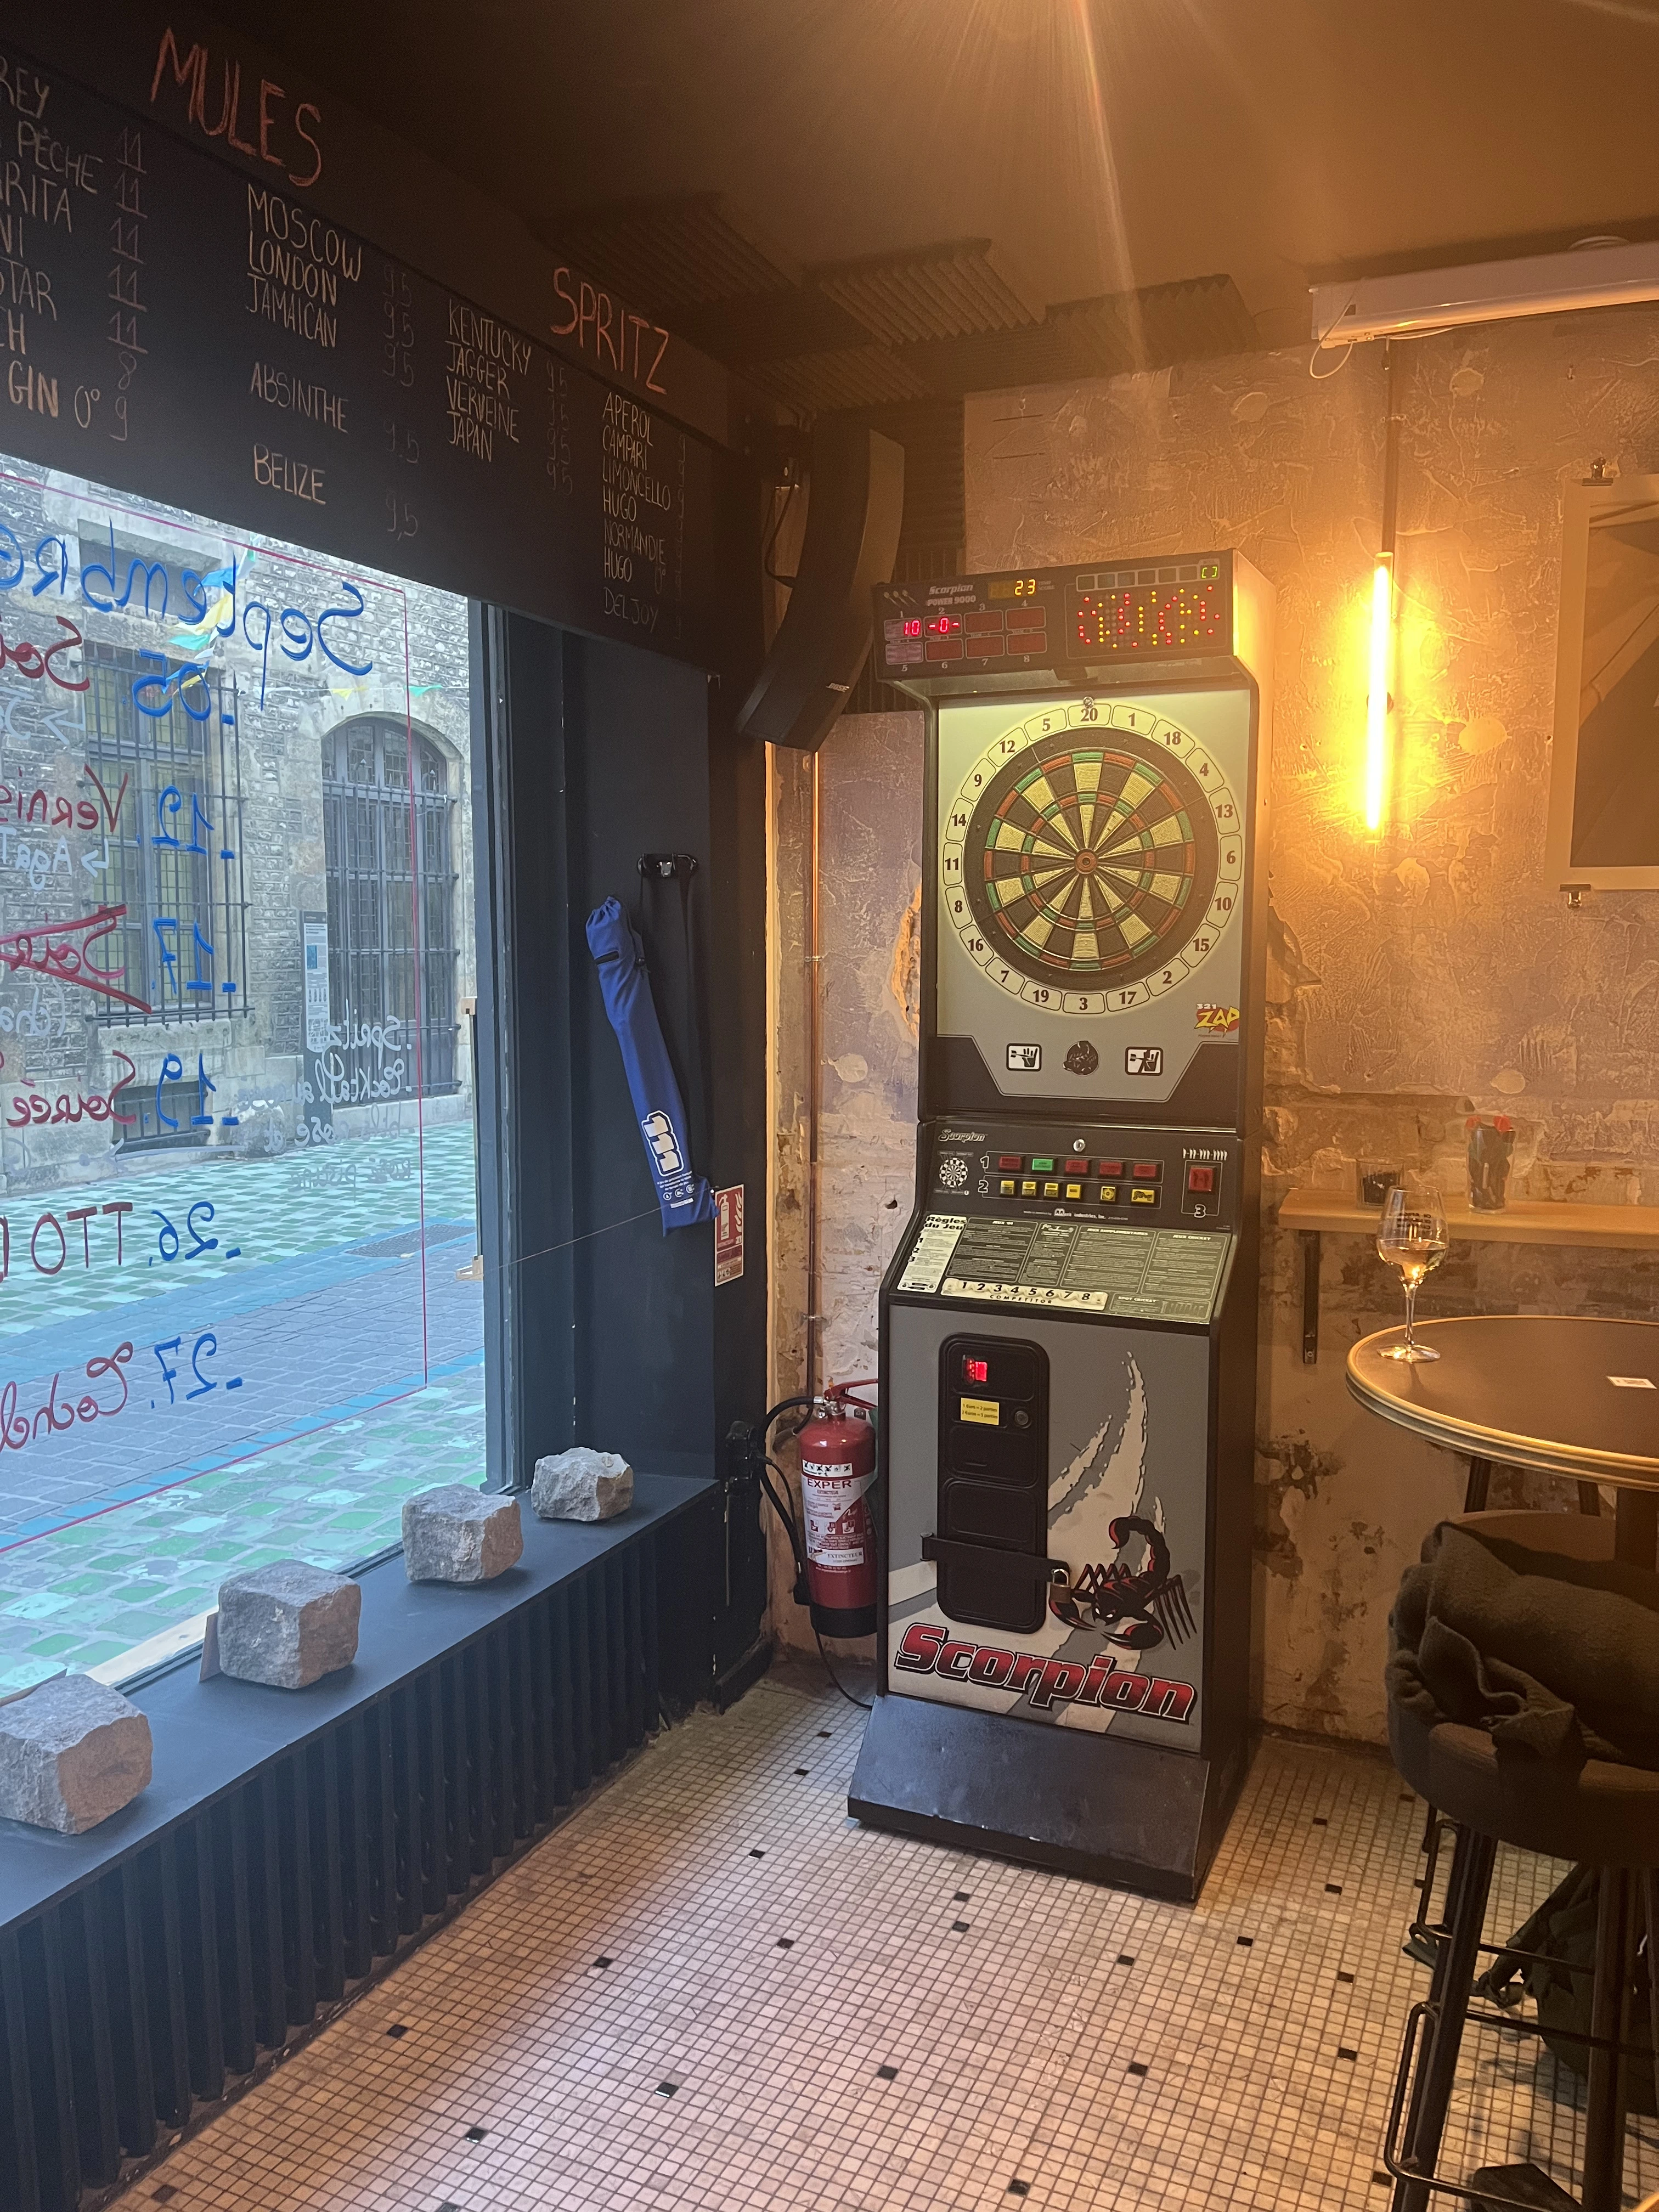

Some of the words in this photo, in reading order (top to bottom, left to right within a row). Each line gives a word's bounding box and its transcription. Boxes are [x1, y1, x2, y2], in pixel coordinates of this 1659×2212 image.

[150, 26, 321, 187] MULES
[0, 161, 72, 233] RITA
[248, 183, 363, 282] MOSCOW
[249, 229, 337, 307] LONDON
[246, 272, 337, 348] JAMAICAN
[448, 298, 532, 376] KENTUCKY
[549, 266, 669, 395] SPRITZ
[444, 340, 511, 401] JAGGER
[8, 359, 59, 419] GIN
[250, 361, 349, 435] ABSINTHE
[445, 375, 520, 444] VERVEINE
[602, 392, 653, 448] APEROL
[445, 410, 493, 463] JAPAN
[602, 425, 647, 471] CAMPARI
[253, 442, 326, 505] BELIZE
[602, 455, 671, 511] LIMONCELLO
[603, 484, 637, 522] HUGO
[604, 517, 667, 566] NORMANDIE
[603, 545, 633, 583] HUGO
[929, 584, 974, 596] Scorpion
[1014, 579, 1036, 596] 23
[927, 597, 953, 607] POWER
[954, 595, 977, 604] 9000
[603, 586, 629, 620] DEL
[630, 598, 658, 634] JOY
[1081, 708, 1098, 722] 20
[1128, 713, 1136, 726] 1
[1042, 719, 1051, 731] 5
[1164, 732, 1181, 746] 18
[1000, 740, 1015, 753] 12
[1199, 763, 1209, 777] 4
[974, 774, 983, 787] 9
[1216, 805, 1233, 818] 13
[952, 814, 967, 827] 14
[945, 858, 959, 871] 11
[1226, 851, 1235, 864] 6
[955, 900, 963, 913] 8
[1215, 897, 1232, 911] 10
[968, 939, 984, 952] 16
[1193, 939, 1210, 952] 15
[1001, 970, 1009, 983] 7
[1163, 970, 1172, 984] 2
[1032, 990, 1049, 1003] 19
[1119, 991, 1137, 1005] 17
[1079, 997, 1088, 1011] 3
[1194, 1006, 1240, 1030] ZAP
[938, 1128, 985, 1143] Scorpion
[980, 1155, 990, 1170] 1
[978, 1180, 989, 1193] 2
[1194, 1204, 1206, 1218] 3
[990, 1294, 1052, 1304] COMPETITOR
[808, 1478, 852, 1489] EXPER
[894, 1622, 1199, 1725] Scorpion
